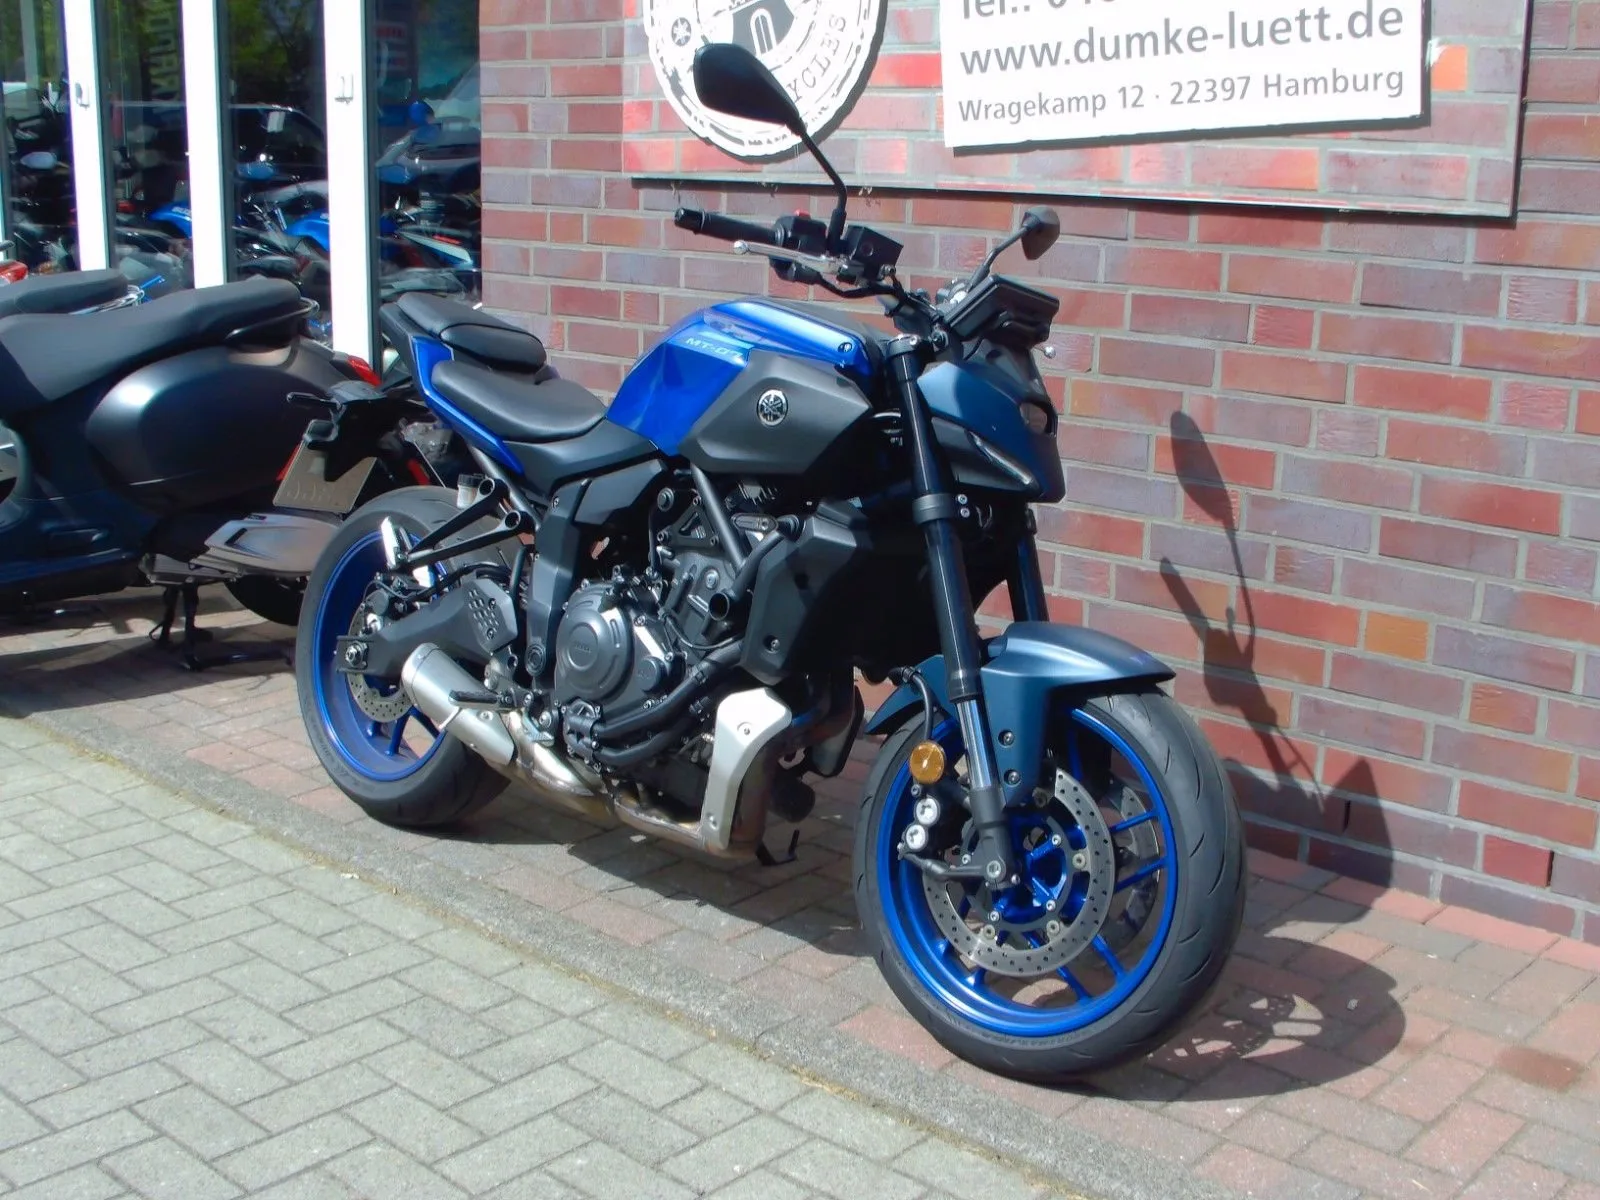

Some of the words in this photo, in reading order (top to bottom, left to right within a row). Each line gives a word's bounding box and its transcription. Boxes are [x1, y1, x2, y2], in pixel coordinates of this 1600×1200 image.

[960, 0, 1403, 75] www.dumke-luett.de
[958, 92, 1107, 125] Wragekamp
[1118, 85, 1145, 109] 12
[1169, 75, 1251, 105] 22397
[1263, 67, 1404, 98] Hamburg
